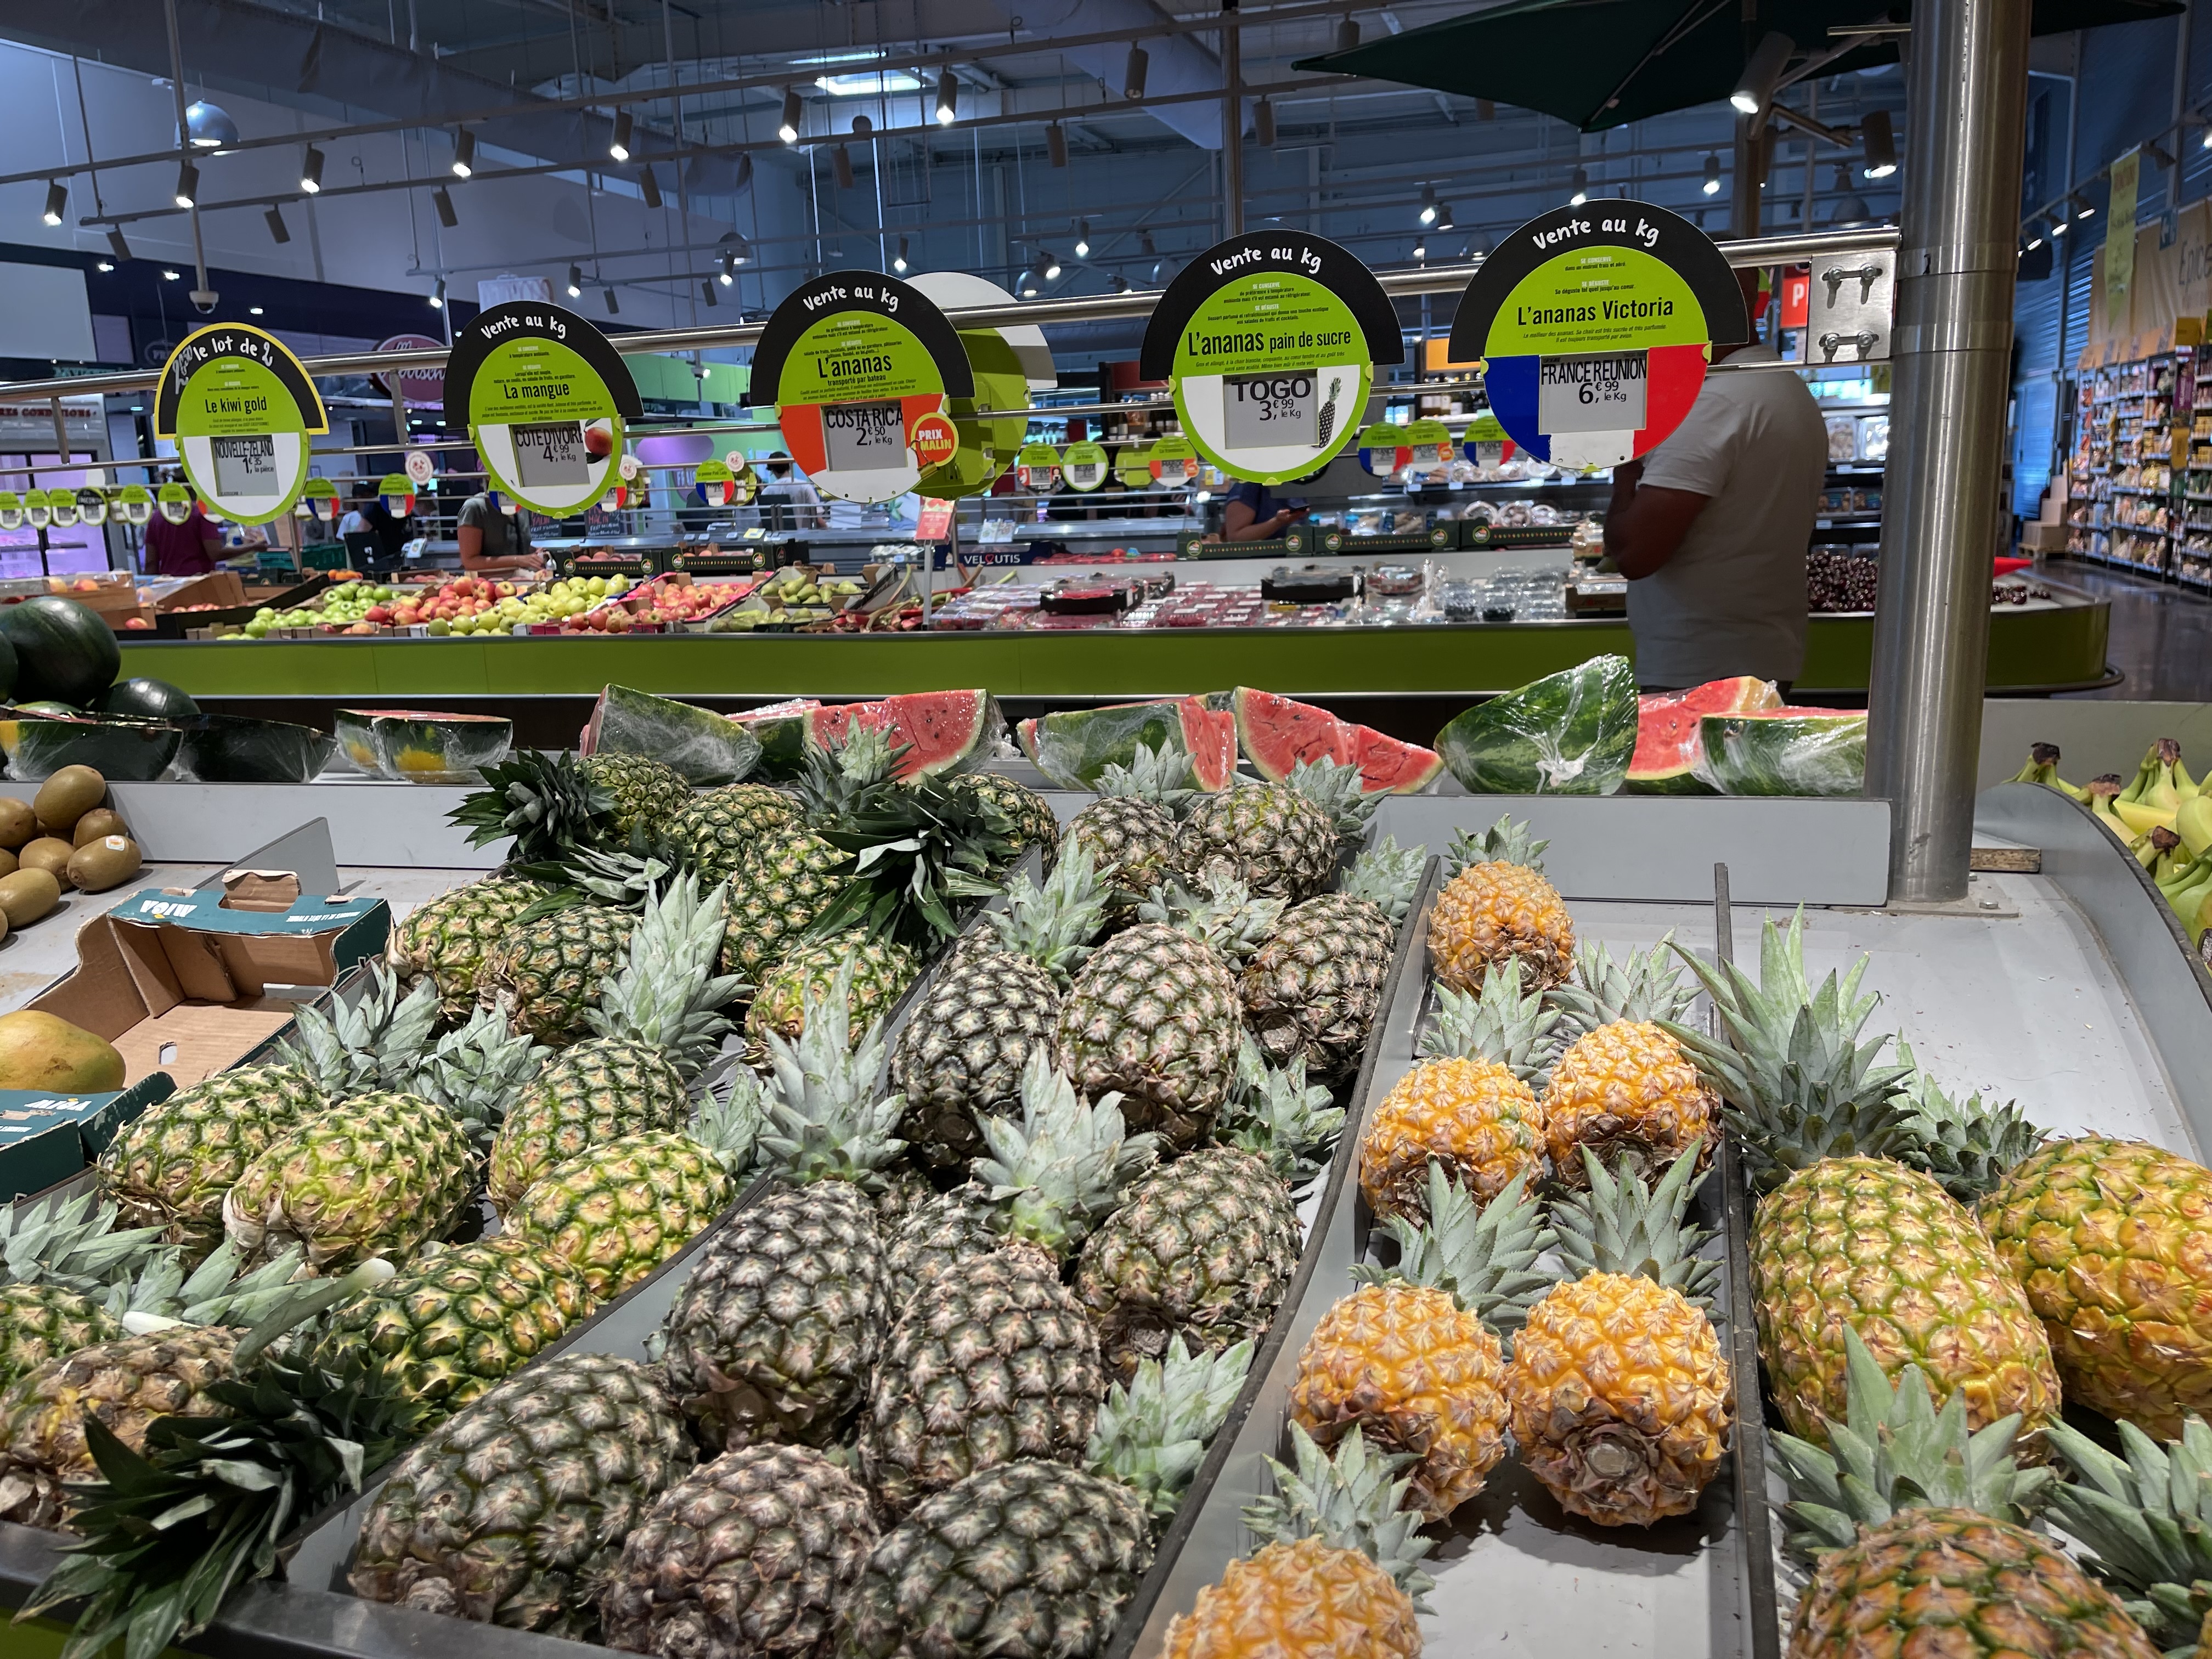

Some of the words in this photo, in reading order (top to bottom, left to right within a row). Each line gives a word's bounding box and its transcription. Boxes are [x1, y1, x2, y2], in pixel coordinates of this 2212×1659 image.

[1532, 219, 1590, 249] Vente
[1602, 219, 1626, 233] au
[1635, 218, 1659, 247] kg
[1211, 247, 1262, 274] Vente
[1271, 248, 1293, 261] au
[1301, 247, 1321, 274] kg
[803, 286, 847, 311] Vente
[854, 287, 873, 299] au
[881, 287, 898, 312] kg
[1518, 305, 1596, 325] L'ananas
[1602, 297, 1673, 320] Victoria
[481, 315, 520, 339] Vente
[526, 316, 543, 327] au
[550, 316, 566, 339] kg
[193, 347, 208, 361] le
[212, 335, 233, 353] lot
[240, 338, 257, 357] de
[262, 341, 273, 367] 2
[1188, 332, 1264, 356] L'ananas
[1269, 332, 1294, 353] pain
[1299, 331, 1313, 347] de
[1317, 331, 1351, 346] sucre
[817, 356, 892, 378] L'ananas
[1542, 361, 1590, 385] FRANCE
[1594, 358, 1646, 382] REUNION
[504, 384, 518, 399] La
[522, 384, 569, 399] mangue
[828, 377, 855, 386] transporté
[1232, 377, 1311, 402] TOGO
[205, 399, 217, 413] Le
[221, 398, 241, 412] kiwi
[245, 396, 267, 414] gold
[1614, 392, 1626, 402] Kg
[826, 409, 871, 428] COSTA
[873, 407, 904, 426] RICA
[1290, 409, 1301, 419] Kg
[883, 436, 892, 444] Kg
[918, 429, 943, 441] PRIX
[921, 439, 952, 450] MALIN
